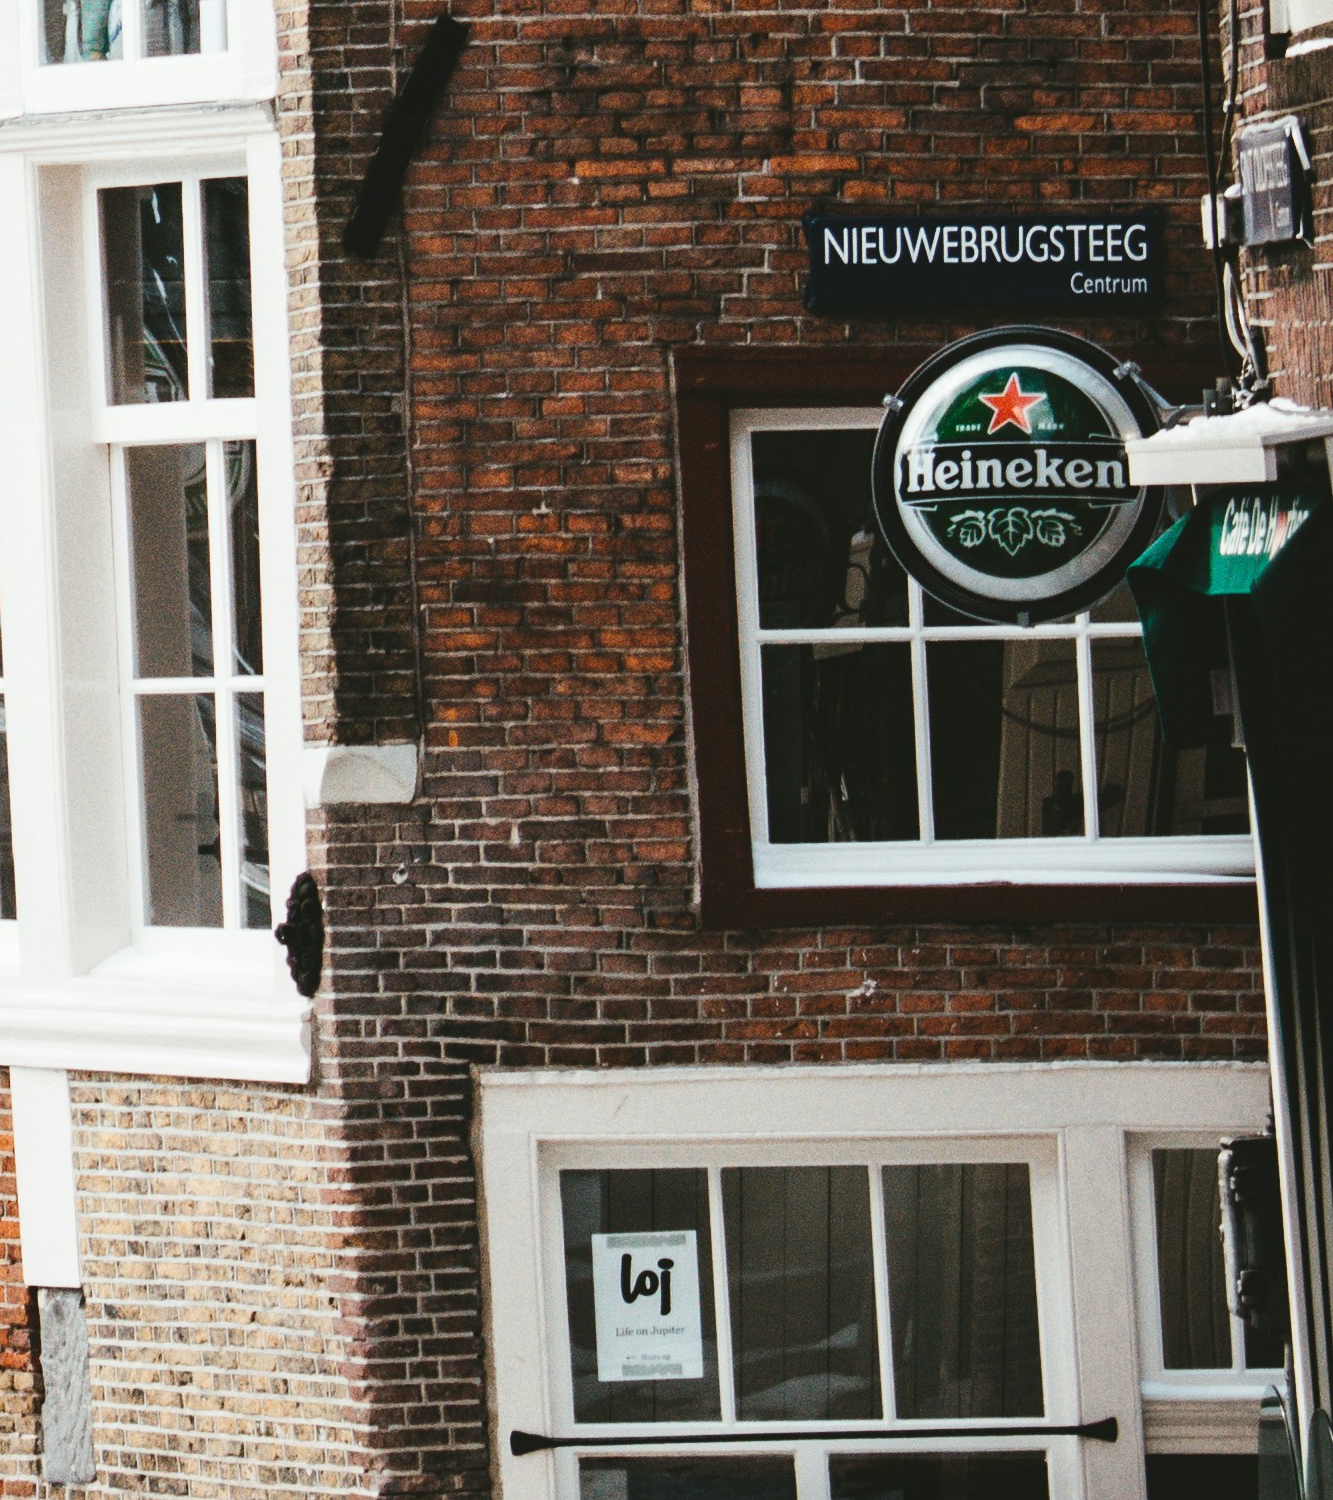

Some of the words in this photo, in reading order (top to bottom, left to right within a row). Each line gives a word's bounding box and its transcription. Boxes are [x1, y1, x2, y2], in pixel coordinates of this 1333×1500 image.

[823, 224, 1148, 265] NIEUWEBRUGSTEEG
[1070, 272, 1148, 295] Centrum
[906, 448, 1126, 493] Heineken
[615, 1327, 634, 1337] Life
[636, 1328, 648, 1336] on
[650, 1326, 685, 1337] Jupiter
